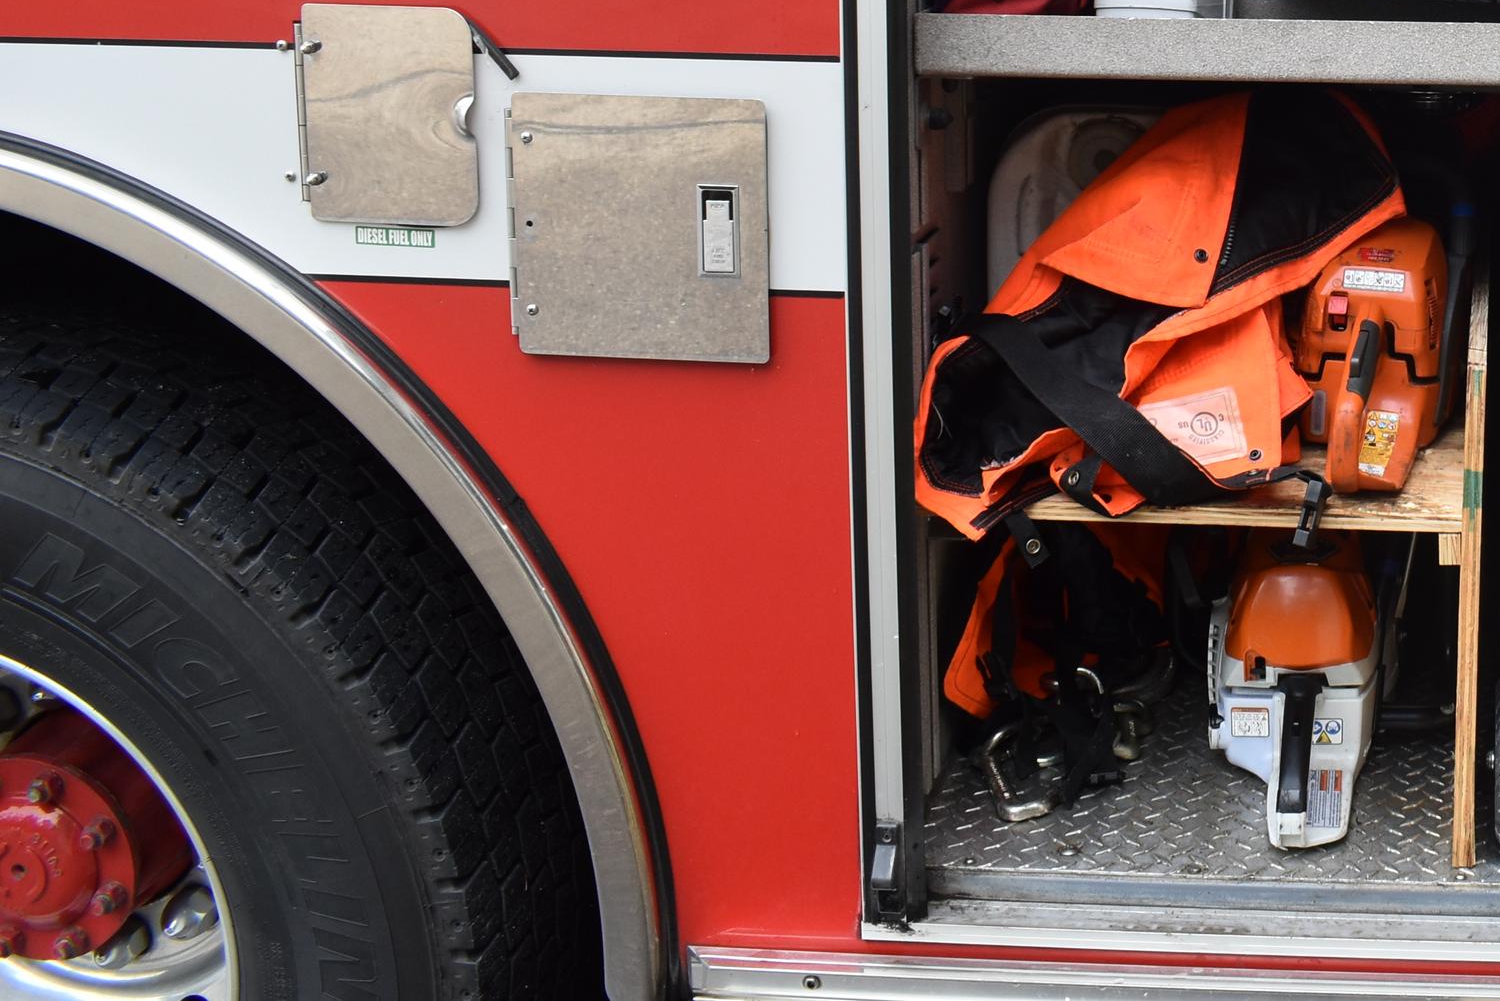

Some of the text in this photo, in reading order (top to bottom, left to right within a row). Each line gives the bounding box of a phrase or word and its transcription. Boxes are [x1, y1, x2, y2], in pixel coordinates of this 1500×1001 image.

[357, 227, 433, 247] DIESEL FUEL ONLY
